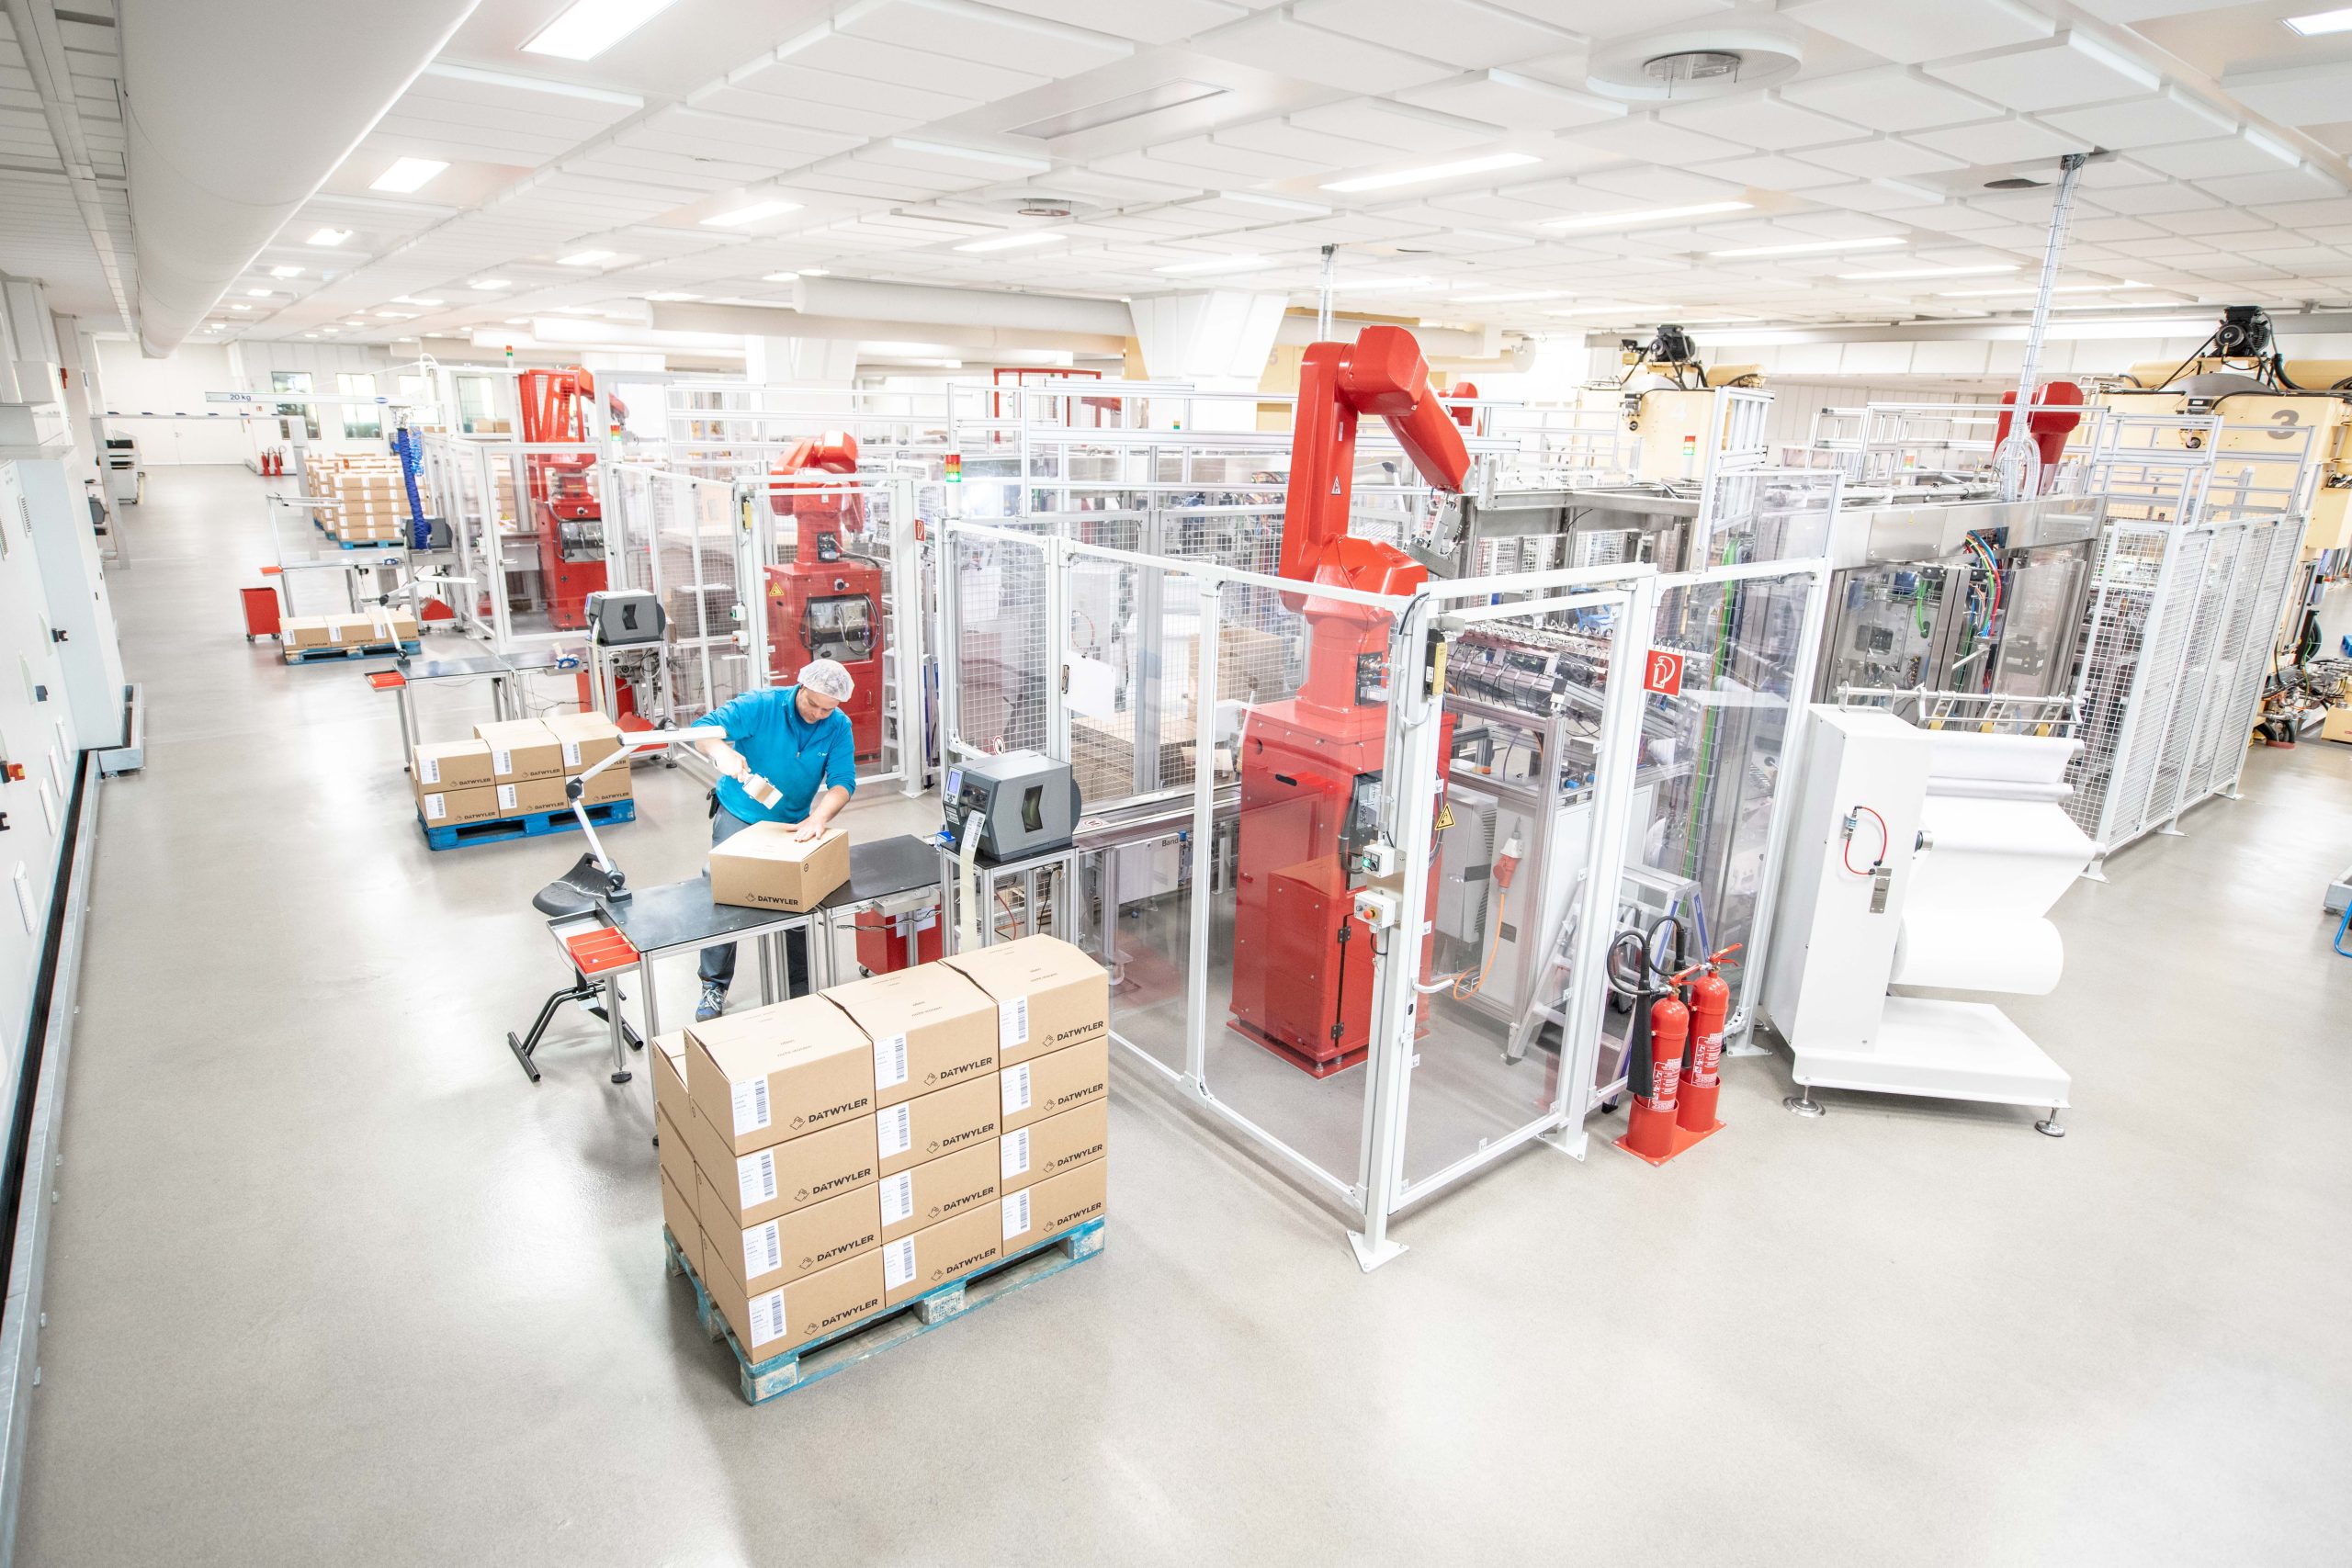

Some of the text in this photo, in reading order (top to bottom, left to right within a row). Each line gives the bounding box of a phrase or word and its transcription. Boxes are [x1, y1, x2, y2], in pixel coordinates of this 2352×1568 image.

[2267, 410, 2300, 440] 3
[458, 778, 492, 786] DATWYLER
[530, 769, 560, 777] DATWYLER
[535, 802, 565, 810] DATWYLER
[601, 792, 629, 800] DATWYLER
[464, 812, 496, 820] DATWYLER
[1161, 838, 1179, 847] Band
[757, 896, 798, 906] DATWYLER
[1057, 1021, 1104, 1042] DATWYLER
[940, 1056, 993, 1080] DATWYLER
[1057, 1083, 1103, 1106] DATWYLER
[808, 1098, 868, 1123] DATWYLER
[943, 1123, 994, 1147] DATWYLER
[1057, 1144, 1103, 1168] DATWYLER
[812, 1168, 871, 1194] DATWYLER
[944, 1187, 994, 1212] DATWYLER
[1057, 1201, 1102, 1226] DATWYLER
[817, 1234, 875, 1262] DATWYLER
[946, 1247, 996, 1274] DATWYLER
[821, 1298, 878, 1328] DATWYLER
